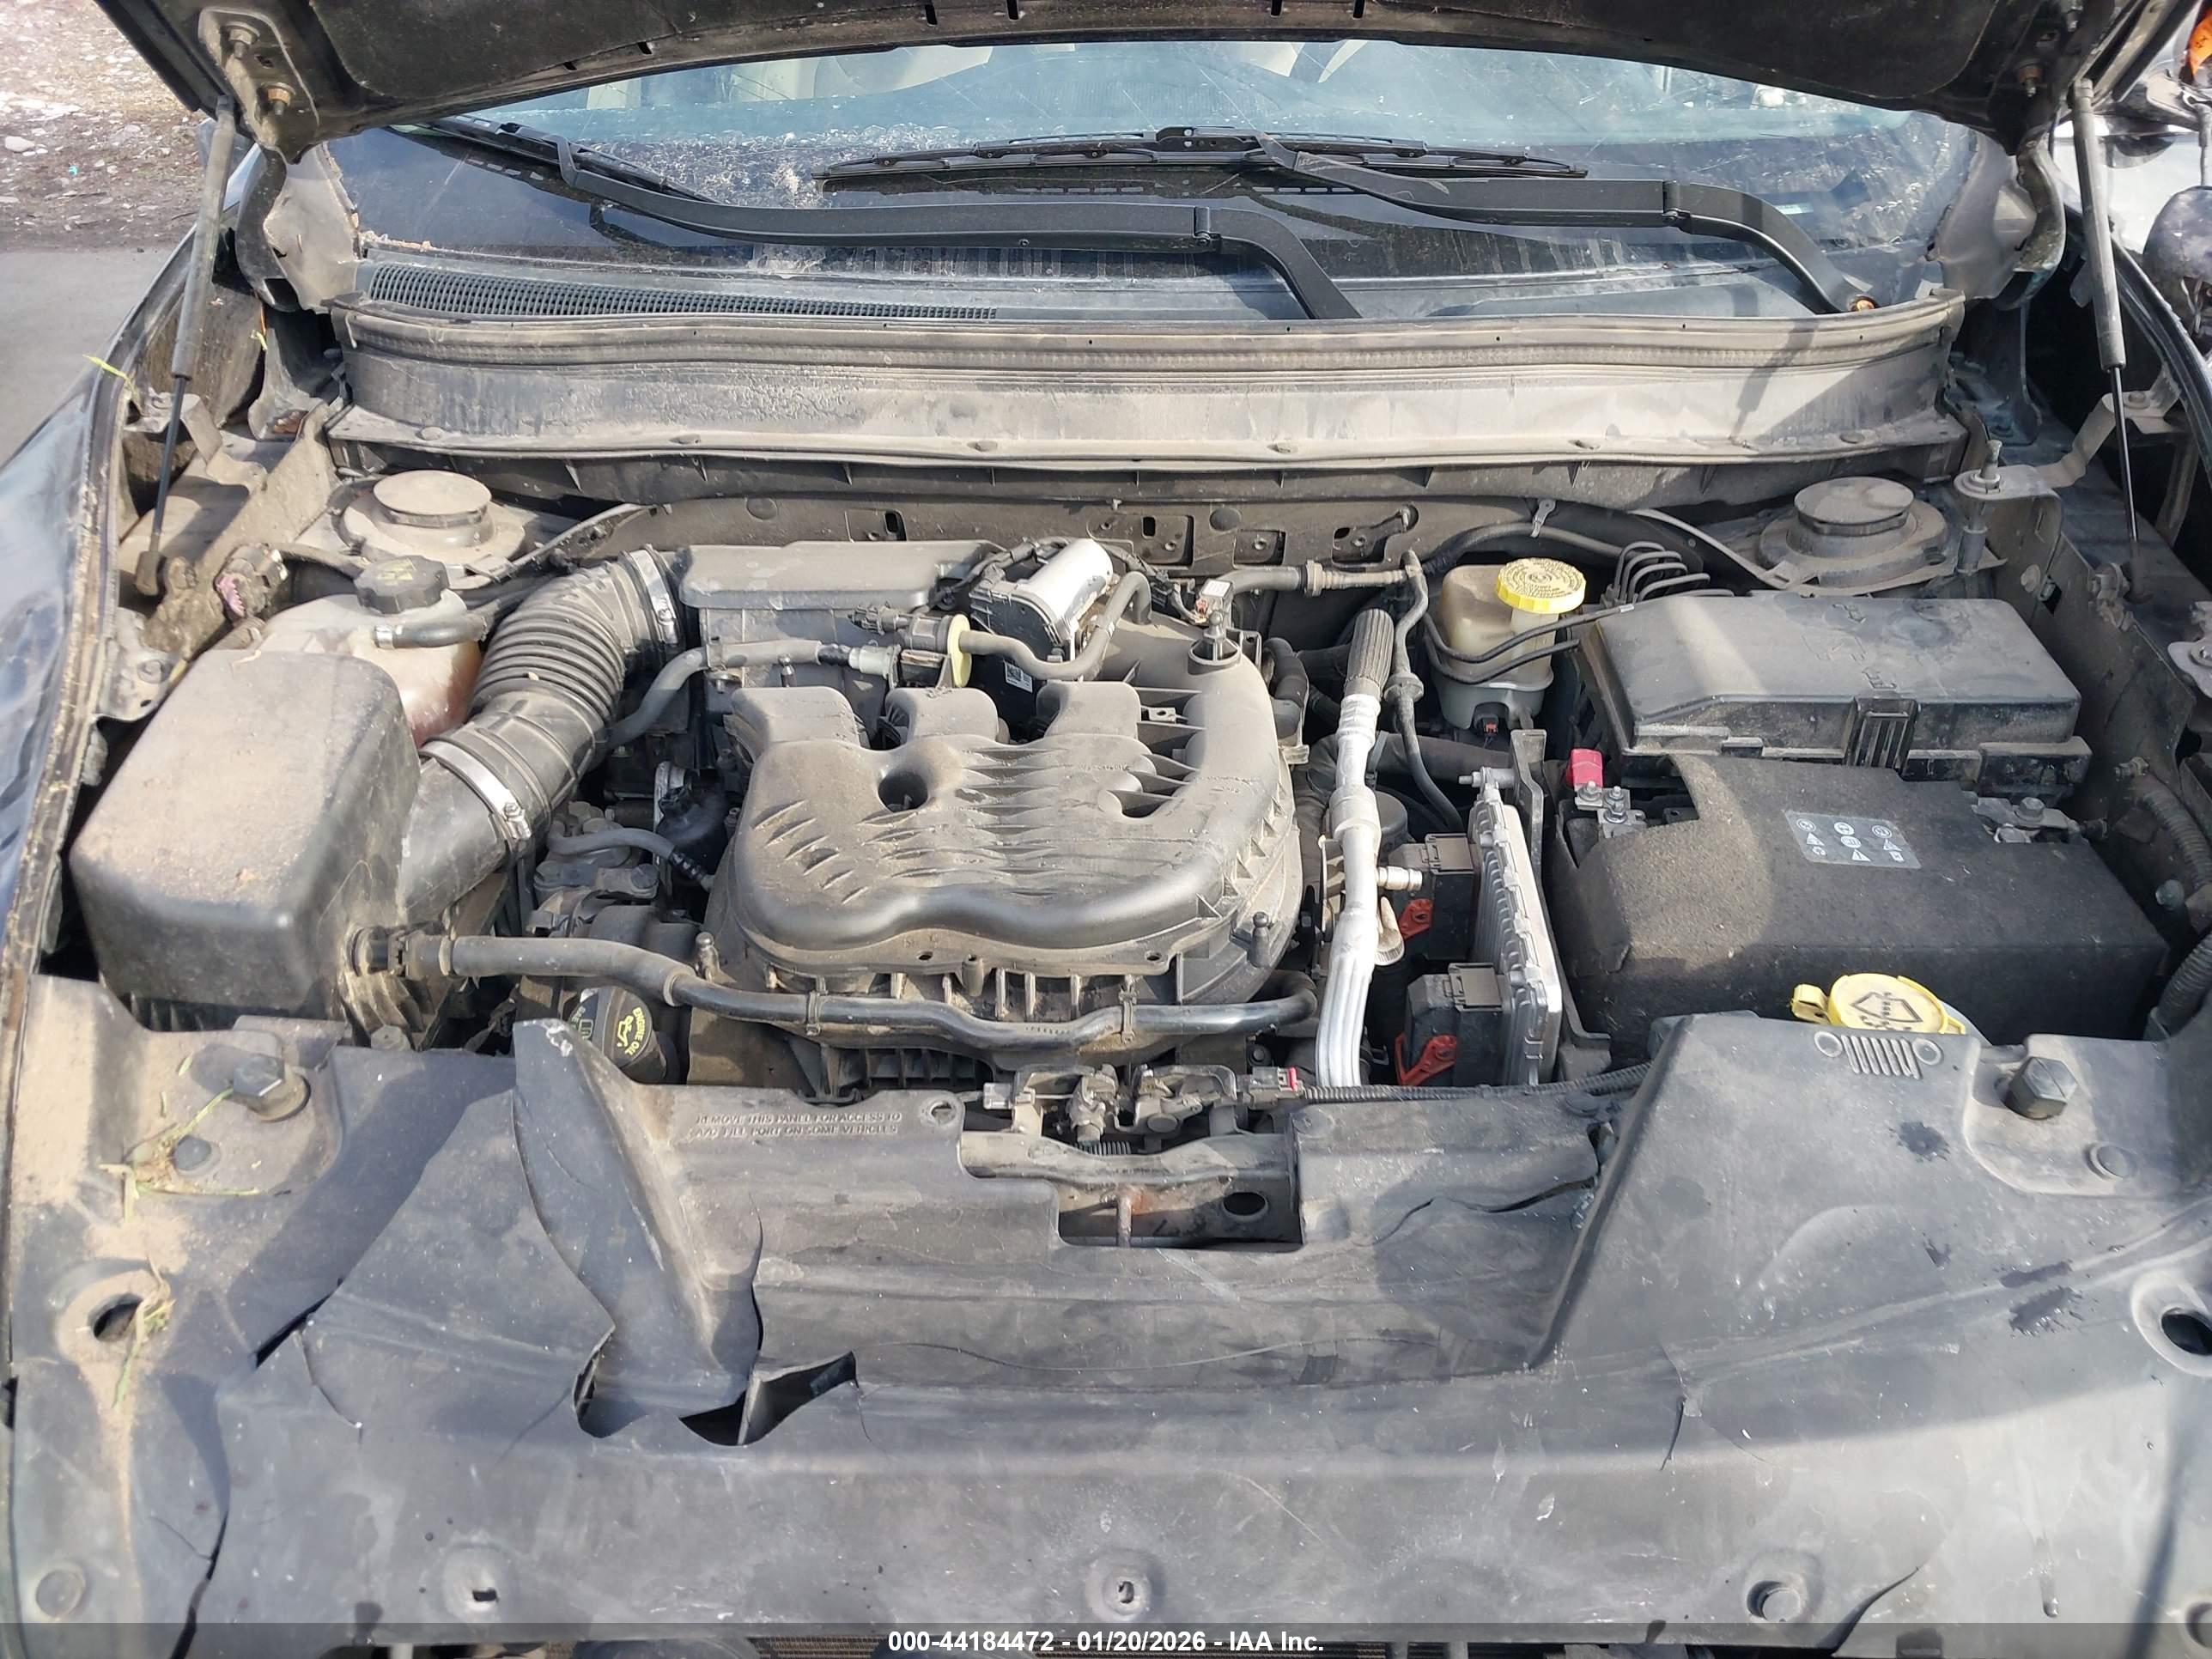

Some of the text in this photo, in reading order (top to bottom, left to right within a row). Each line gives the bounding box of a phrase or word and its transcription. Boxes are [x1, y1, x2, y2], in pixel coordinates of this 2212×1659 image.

[625, 1007, 646, 1055] ENGINE OIL
[696, 1112, 902, 1125] REMOVE THIS PANEL FOR ACCESS TO
[696, 1127, 719, 1139] A/C
[750, 1126, 781, 1138] PORT
[783, 1125, 804, 1136] ON
[805, 1125, 840, 1136] SOME
